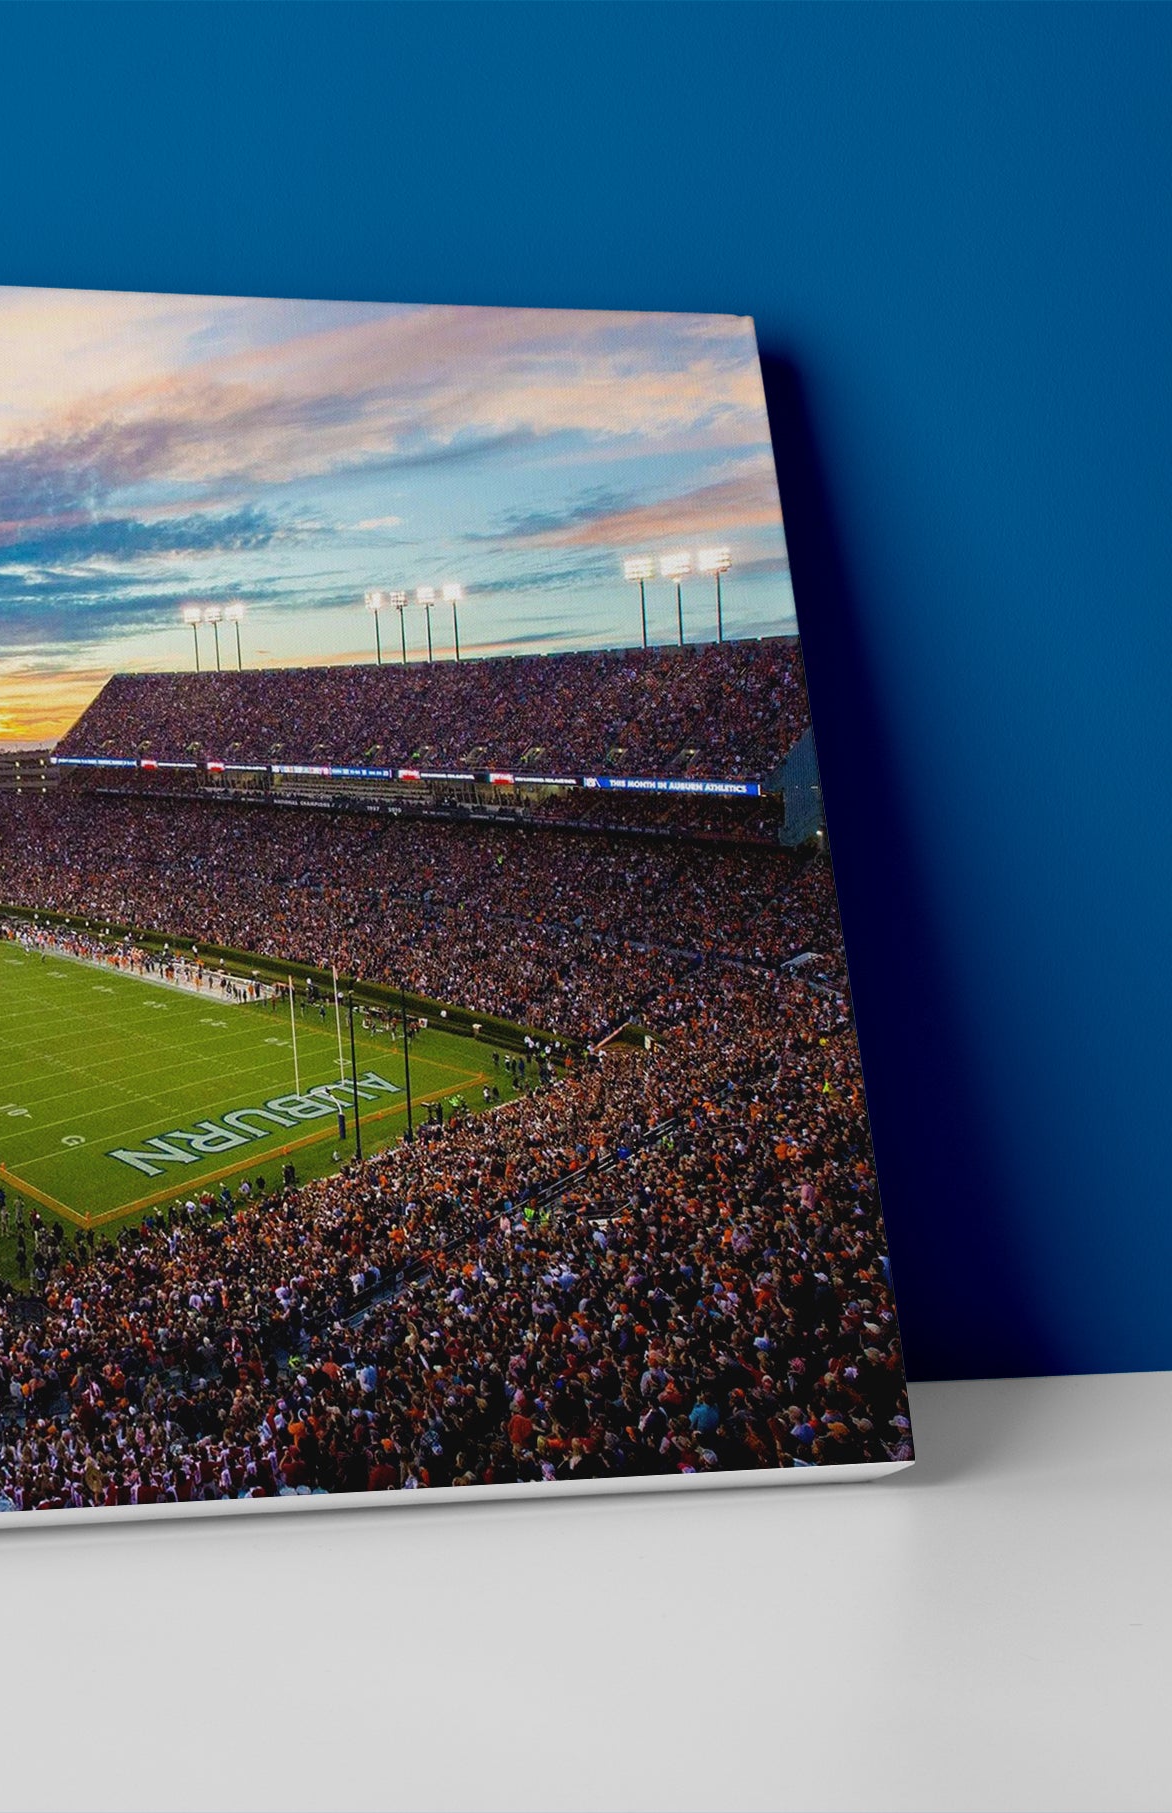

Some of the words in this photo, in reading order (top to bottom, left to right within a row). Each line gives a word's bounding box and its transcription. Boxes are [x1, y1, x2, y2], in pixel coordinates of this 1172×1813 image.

[609, 779, 626, 788] THIS
[627, 780, 656, 789] MONTH
[657, 781, 667, 790] IN
[669, 782, 703, 791] AUBURN
[704, 783, 747, 793] ATHLETICS
[107, 1070, 403, 1178] AUBURN
